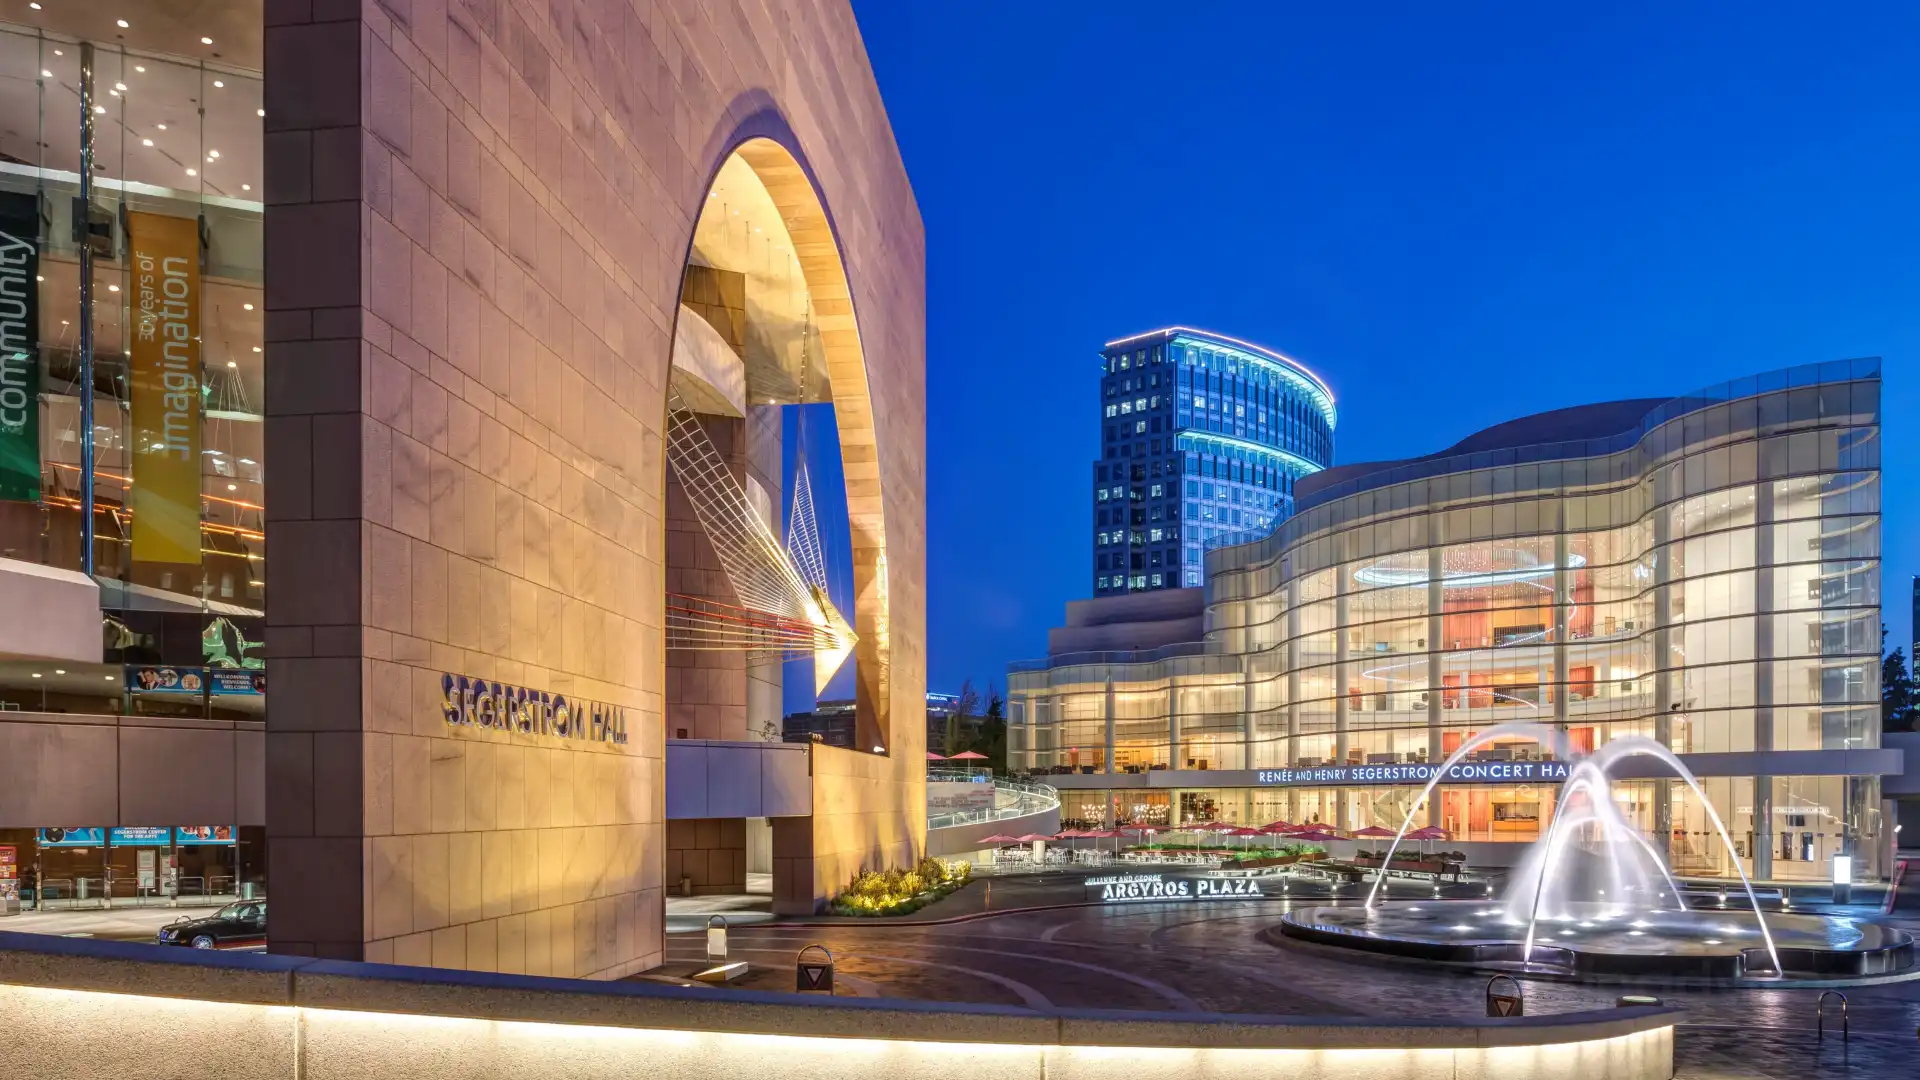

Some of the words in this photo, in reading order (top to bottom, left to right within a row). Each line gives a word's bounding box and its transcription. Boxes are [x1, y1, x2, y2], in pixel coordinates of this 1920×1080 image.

[136, 251, 154, 271] of
[140, 275, 157, 319] years
[445, 680, 586, 740] SEGERSTROM
[590, 704, 628, 744] HALL
[1259, 769, 1292, 782] RENÉE
[1295, 770, 1312, 780] AND
[1314, 769, 1347, 780] HENRY
[1352, 767, 1439, 780] SEGERSTROM
[1450, 765, 1533, 777] CONCERT
[1118, 875, 1133, 883] AND
[1134, 874, 1162, 882] GEORGE
[1102, 881, 1188, 898] ARGYROS
[1197, 879, 1261, 895] PLAZA
